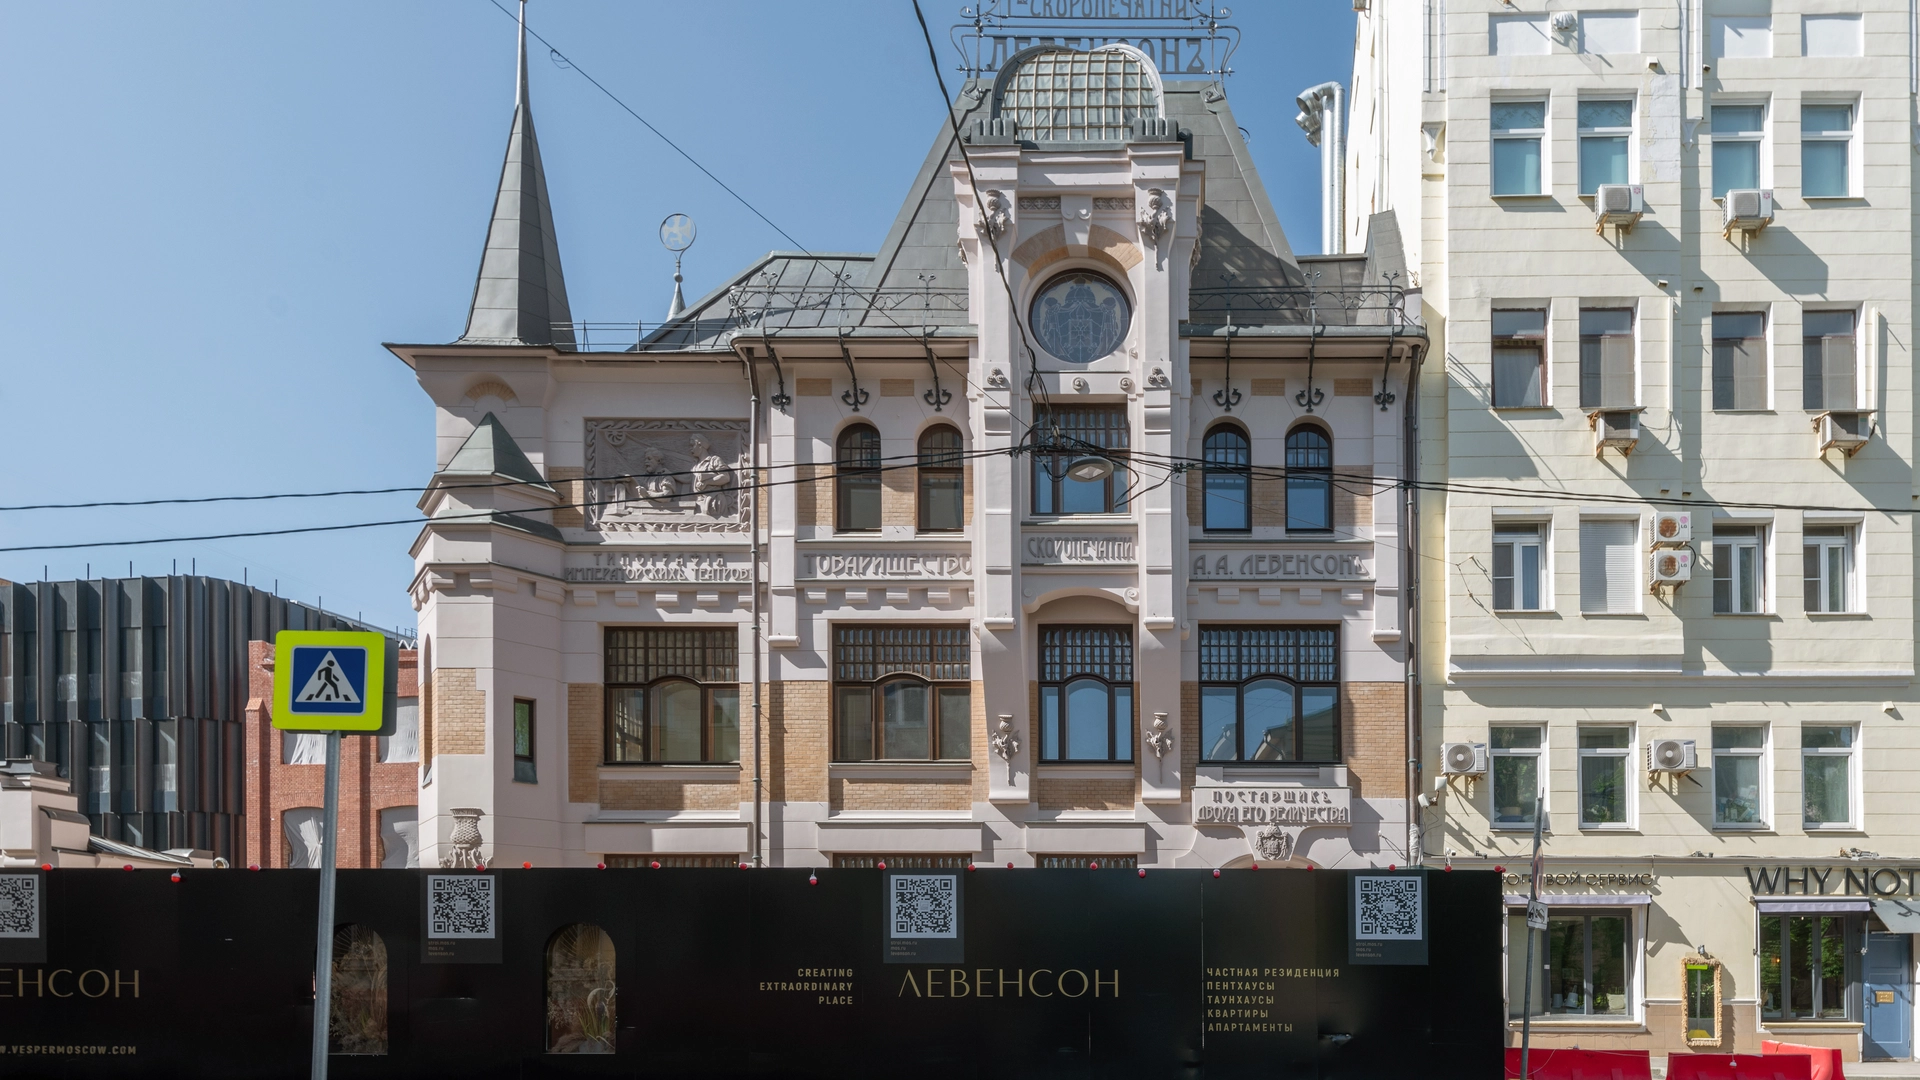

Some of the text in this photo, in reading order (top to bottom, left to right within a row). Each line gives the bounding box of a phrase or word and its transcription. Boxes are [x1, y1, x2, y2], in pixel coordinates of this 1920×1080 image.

[803, 553, 972, 575] ТОВАРИЩЕСТВО
[1194, 554, 1370, 576] А. А. ЛЕВЕНСОНЪ
[691, 567, 753, 581] ТЕАТРОВ
[1213, 790, 1332, 804] ПОСТАВЩИКЪ
[1198, 806, 1347, 821] ДВОРА ЕГО ВЕЛИЧЕСТВА
[1586, 873, 1653, 886] СЕРВИС
[1744, 866, 1920, 896] WHY NOT
[797, 968, 853, 977] CREATING
[1206, 967, 1339, 978] ЧАСТНАЯ РЕЗИДЕНЦИЯ
[760, 982, 853, 991] EXTRAORDINARY
[898, 968, 1119, 998] ЛЕВЕНСОН
[1206, 982, 1275, 991] ПЕНТХАУСЫ
[818, 996, 853, 1005] PLACE
[1207, 995, 1274, 1005] ТАУНХАУСЫ
[1207, 1009, 1269, 1018] КВАРТИРЫ
[1208, 1023, 1293, 1032] АПАРТАМЕНТЫ
